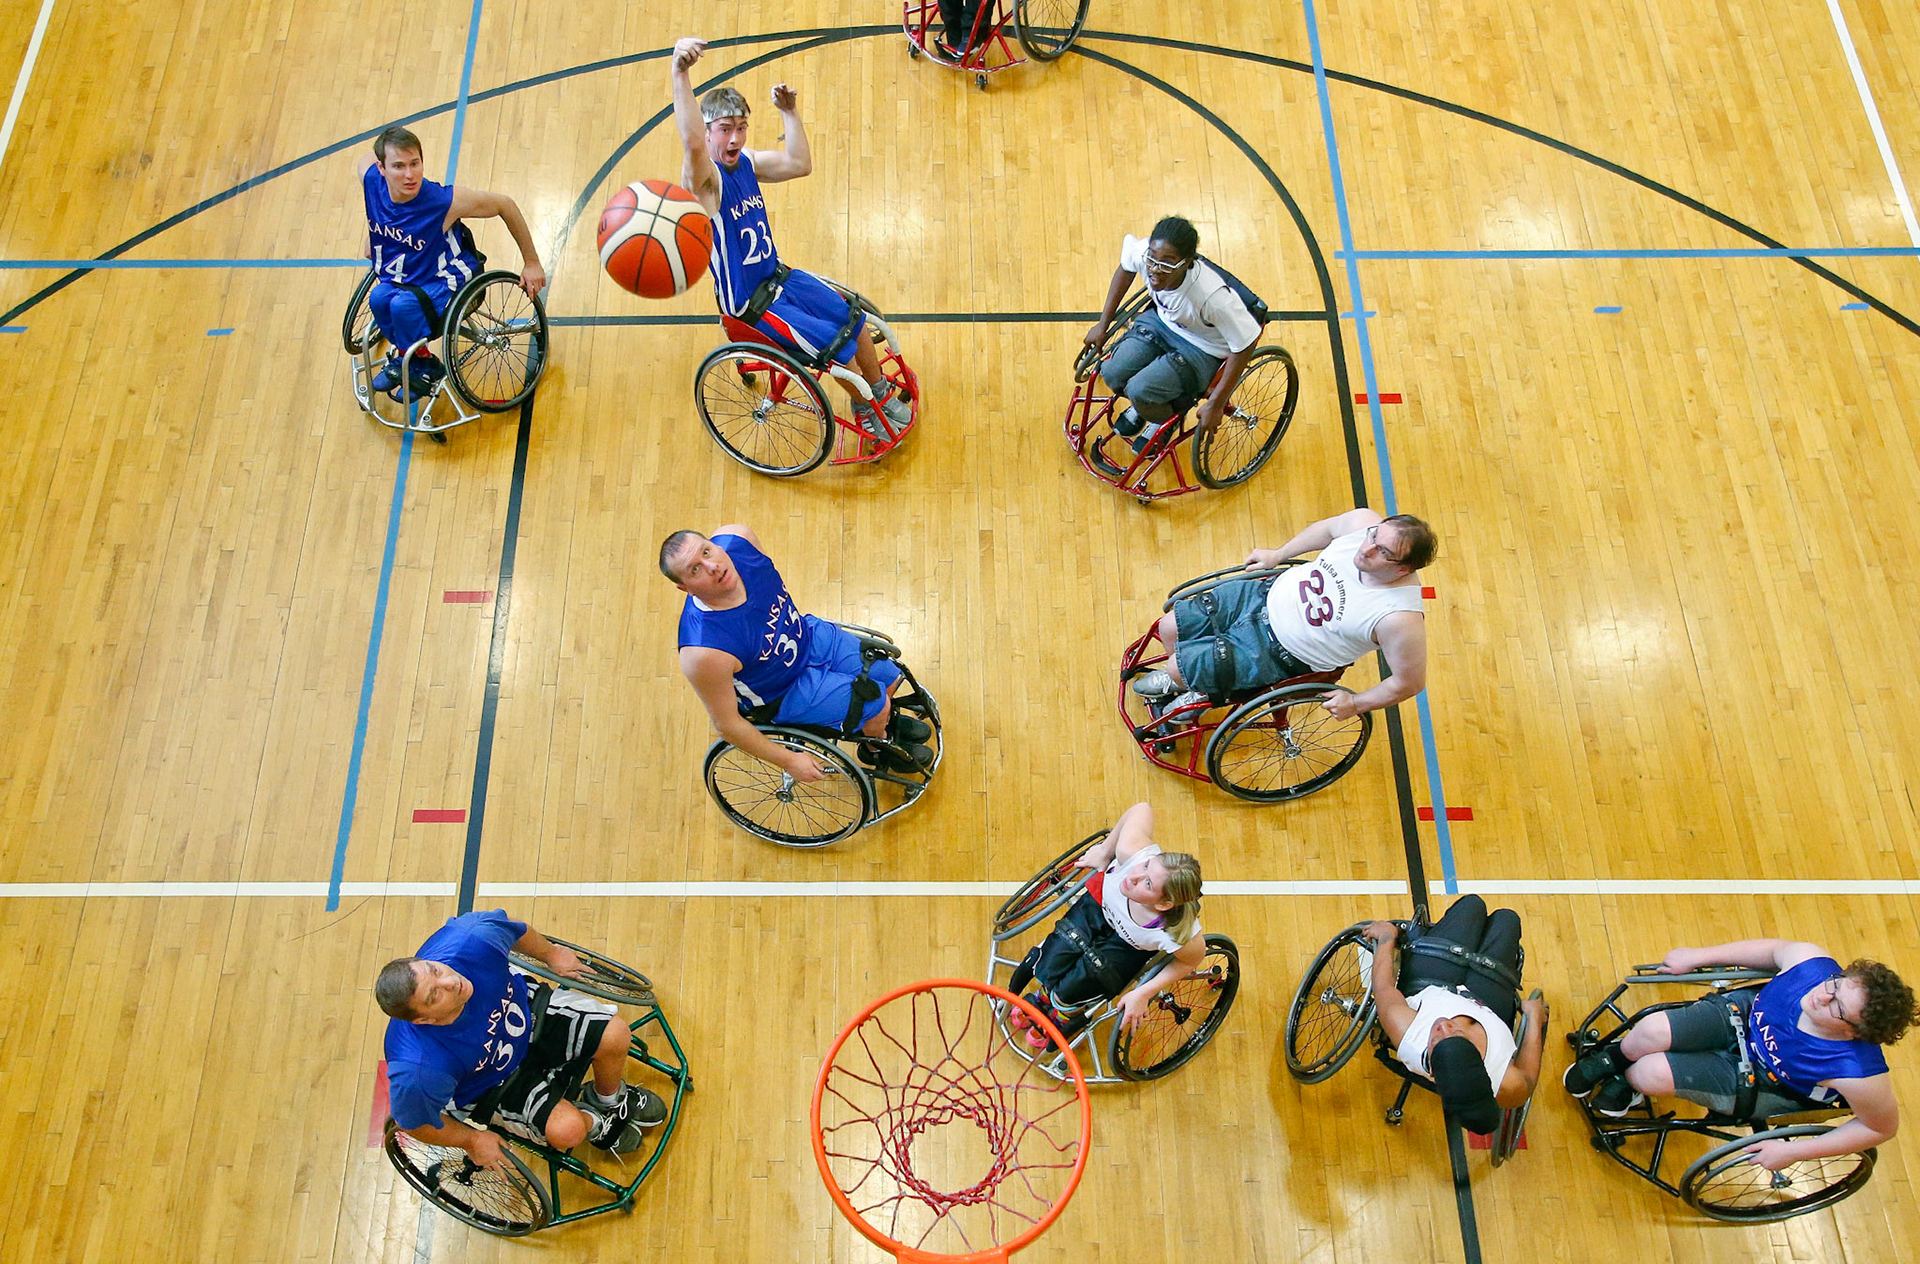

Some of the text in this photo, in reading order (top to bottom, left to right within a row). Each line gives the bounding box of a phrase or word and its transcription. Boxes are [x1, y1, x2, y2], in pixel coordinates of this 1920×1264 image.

[730, 194, 764, 220] KANAS
[374, 244, 408, 284] 14
[740, 220, 773, 266] 23
[1299, 569, 1334, 627] 23
[1319, 558, 1346, 622] Tulsa Jammers
[474, 981, 514, 1072] KANSAS
[490, 1002, 527, 1072] 30
